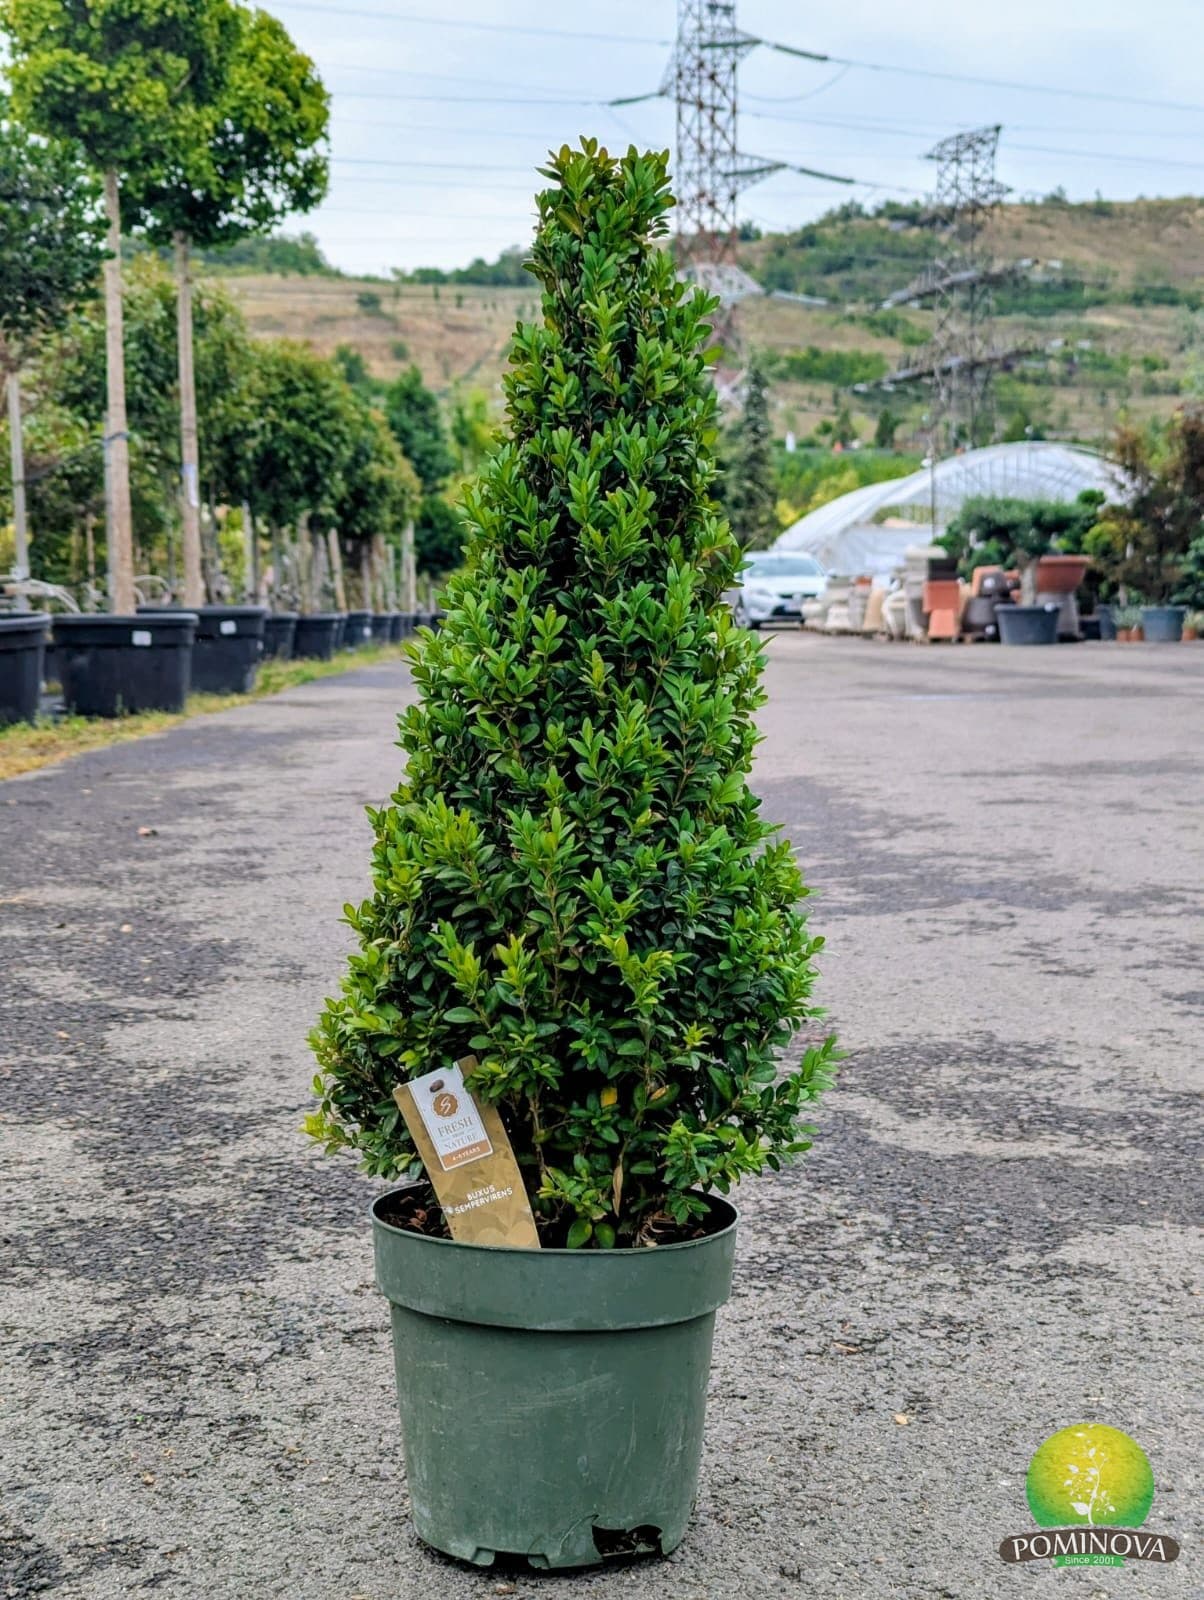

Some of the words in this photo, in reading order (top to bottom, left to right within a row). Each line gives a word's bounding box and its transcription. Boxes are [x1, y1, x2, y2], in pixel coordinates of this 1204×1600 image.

[437, 1116, 473, 1136] FRESH
[454, 1187, 513, 1214] SEMPERVIRENS
[466, 1184, 496, 1201] BUXUS
